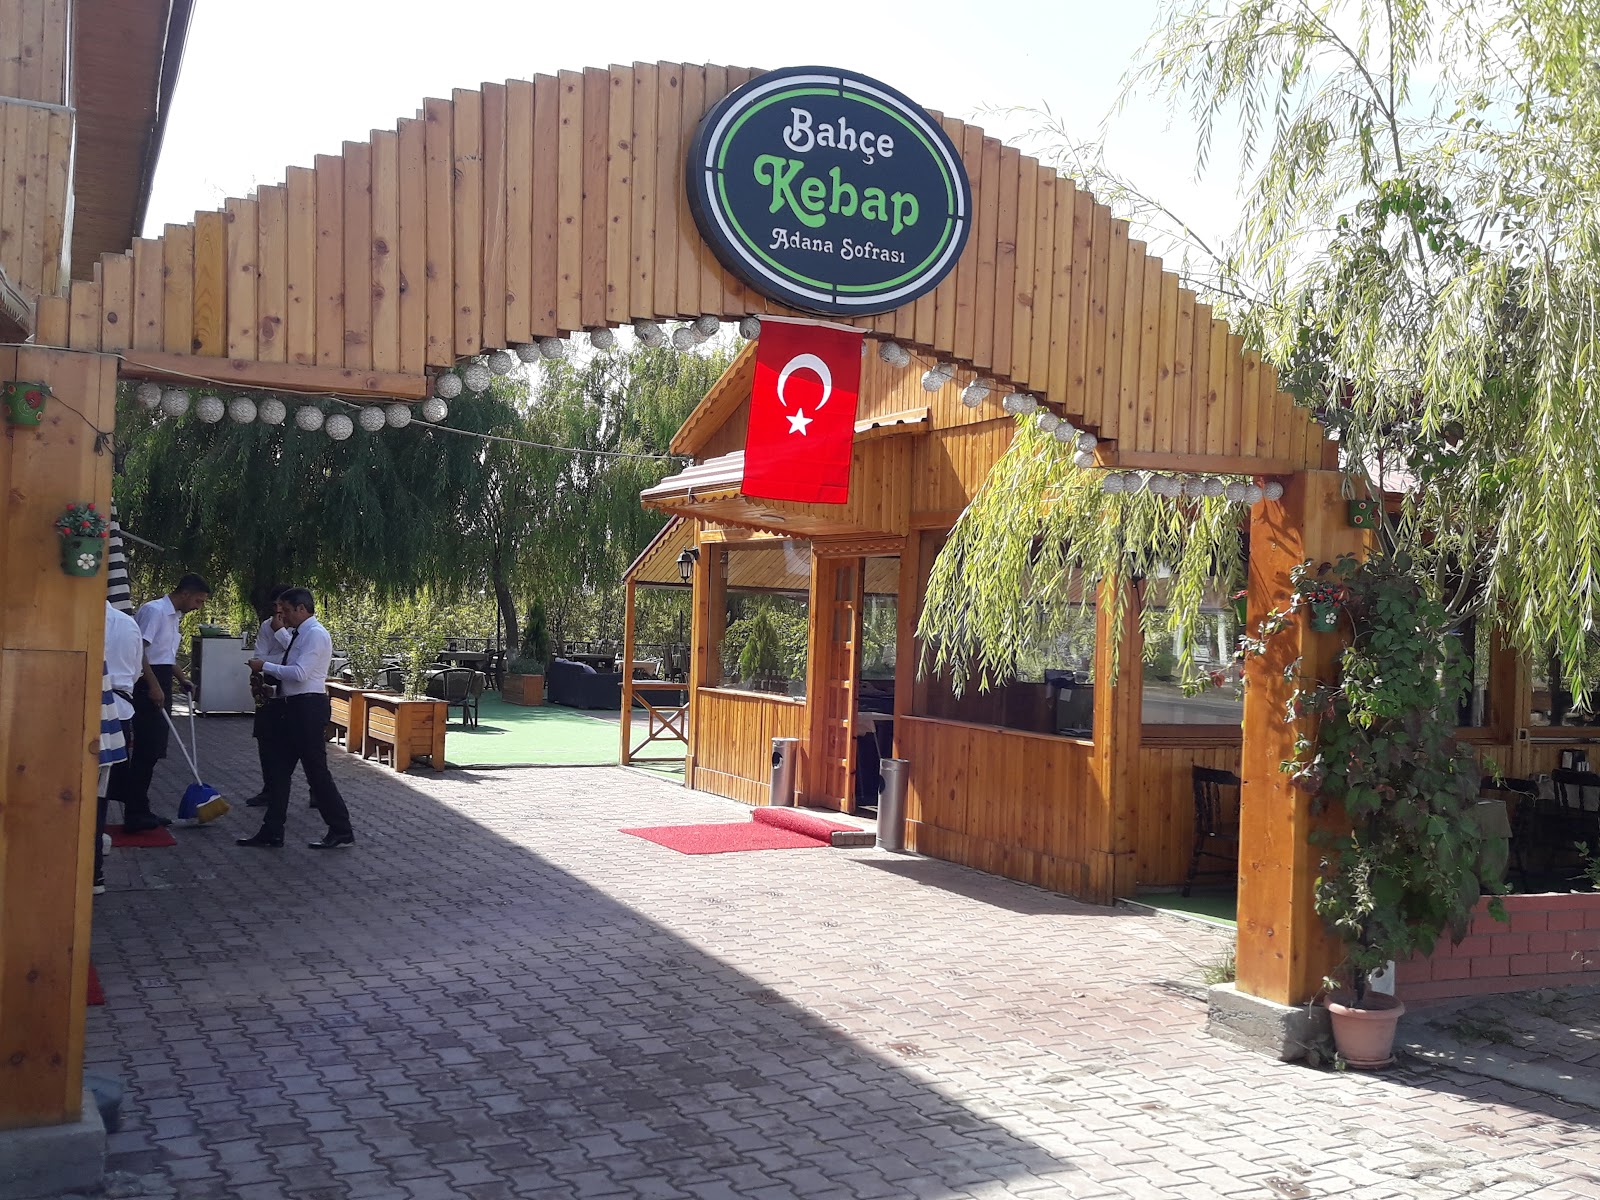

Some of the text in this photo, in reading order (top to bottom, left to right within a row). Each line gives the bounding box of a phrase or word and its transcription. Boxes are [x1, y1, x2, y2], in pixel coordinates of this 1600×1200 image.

[783, 107, 894, 165] Bahçe
[753, 154, 919, 235] Kebap
[769, 227, 906, 264] Adana Sofrası
